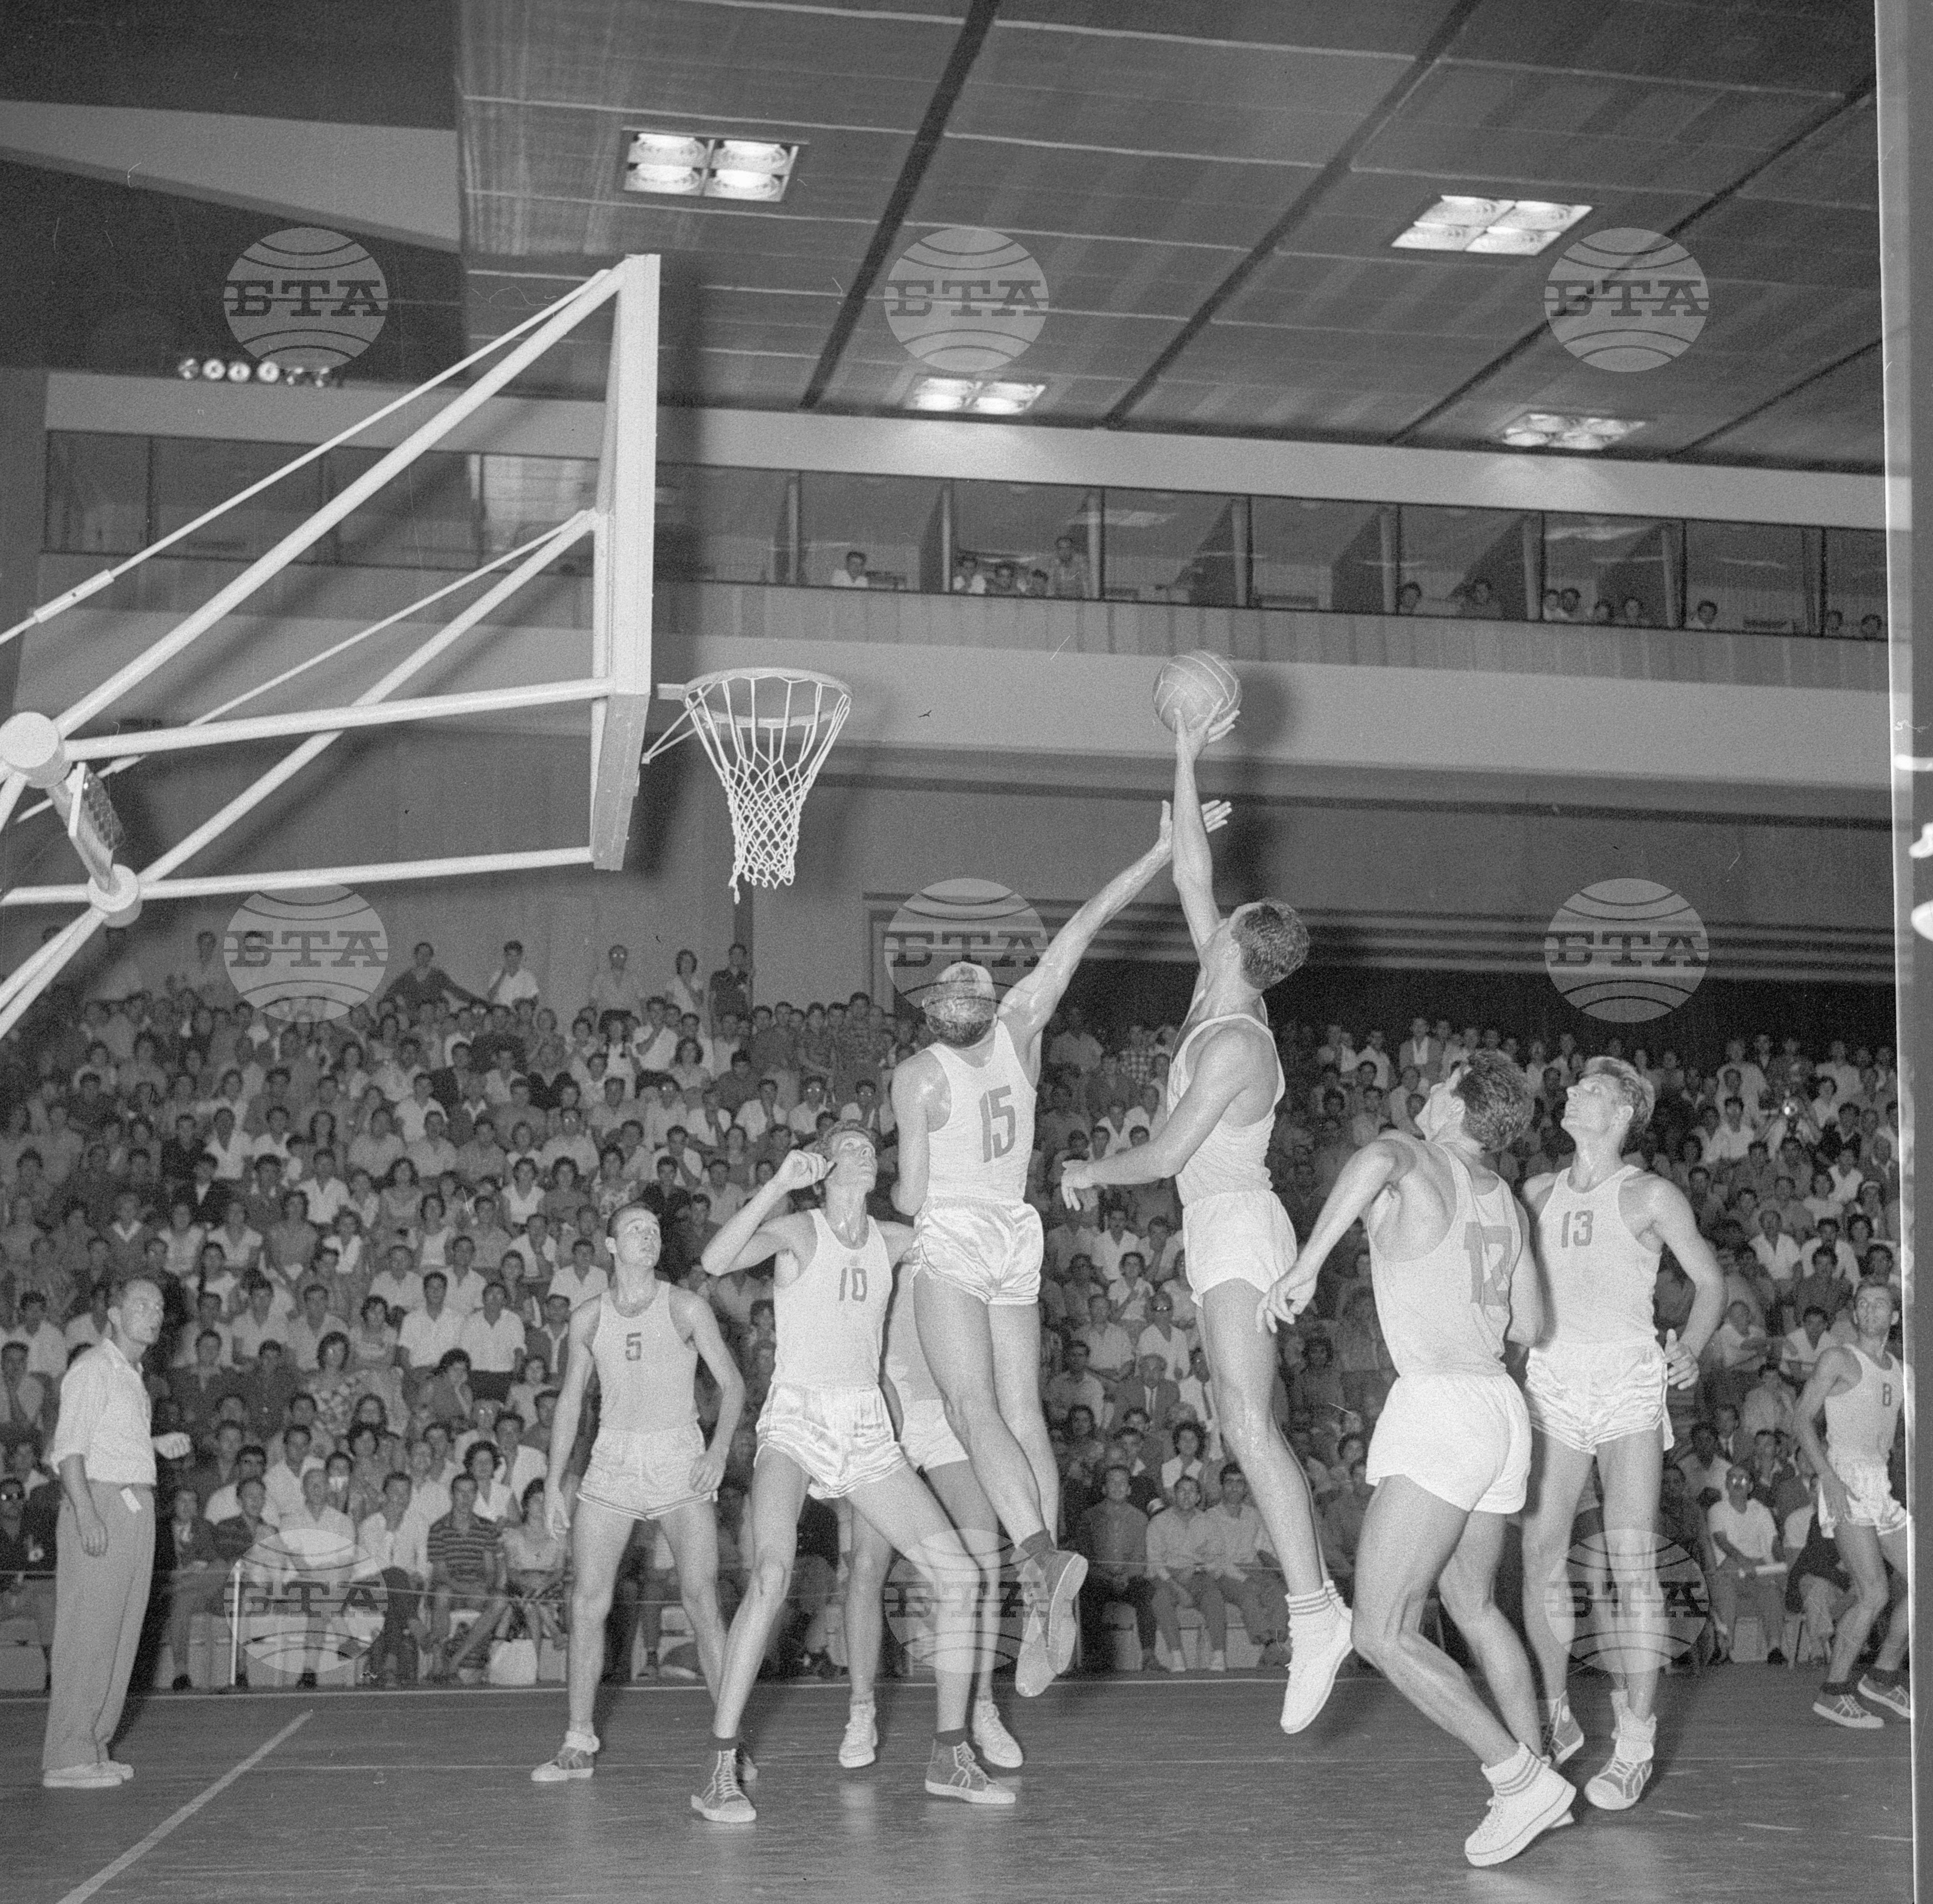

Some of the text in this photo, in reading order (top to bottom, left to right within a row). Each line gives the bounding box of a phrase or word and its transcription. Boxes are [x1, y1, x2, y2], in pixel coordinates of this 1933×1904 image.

[979, 1086, 1015, 1163] 15
[1561, 1210, 1593, 1248] 13
[839, 1267, 867, 1302] 10
[625, 1332, 642, 1361] 5
